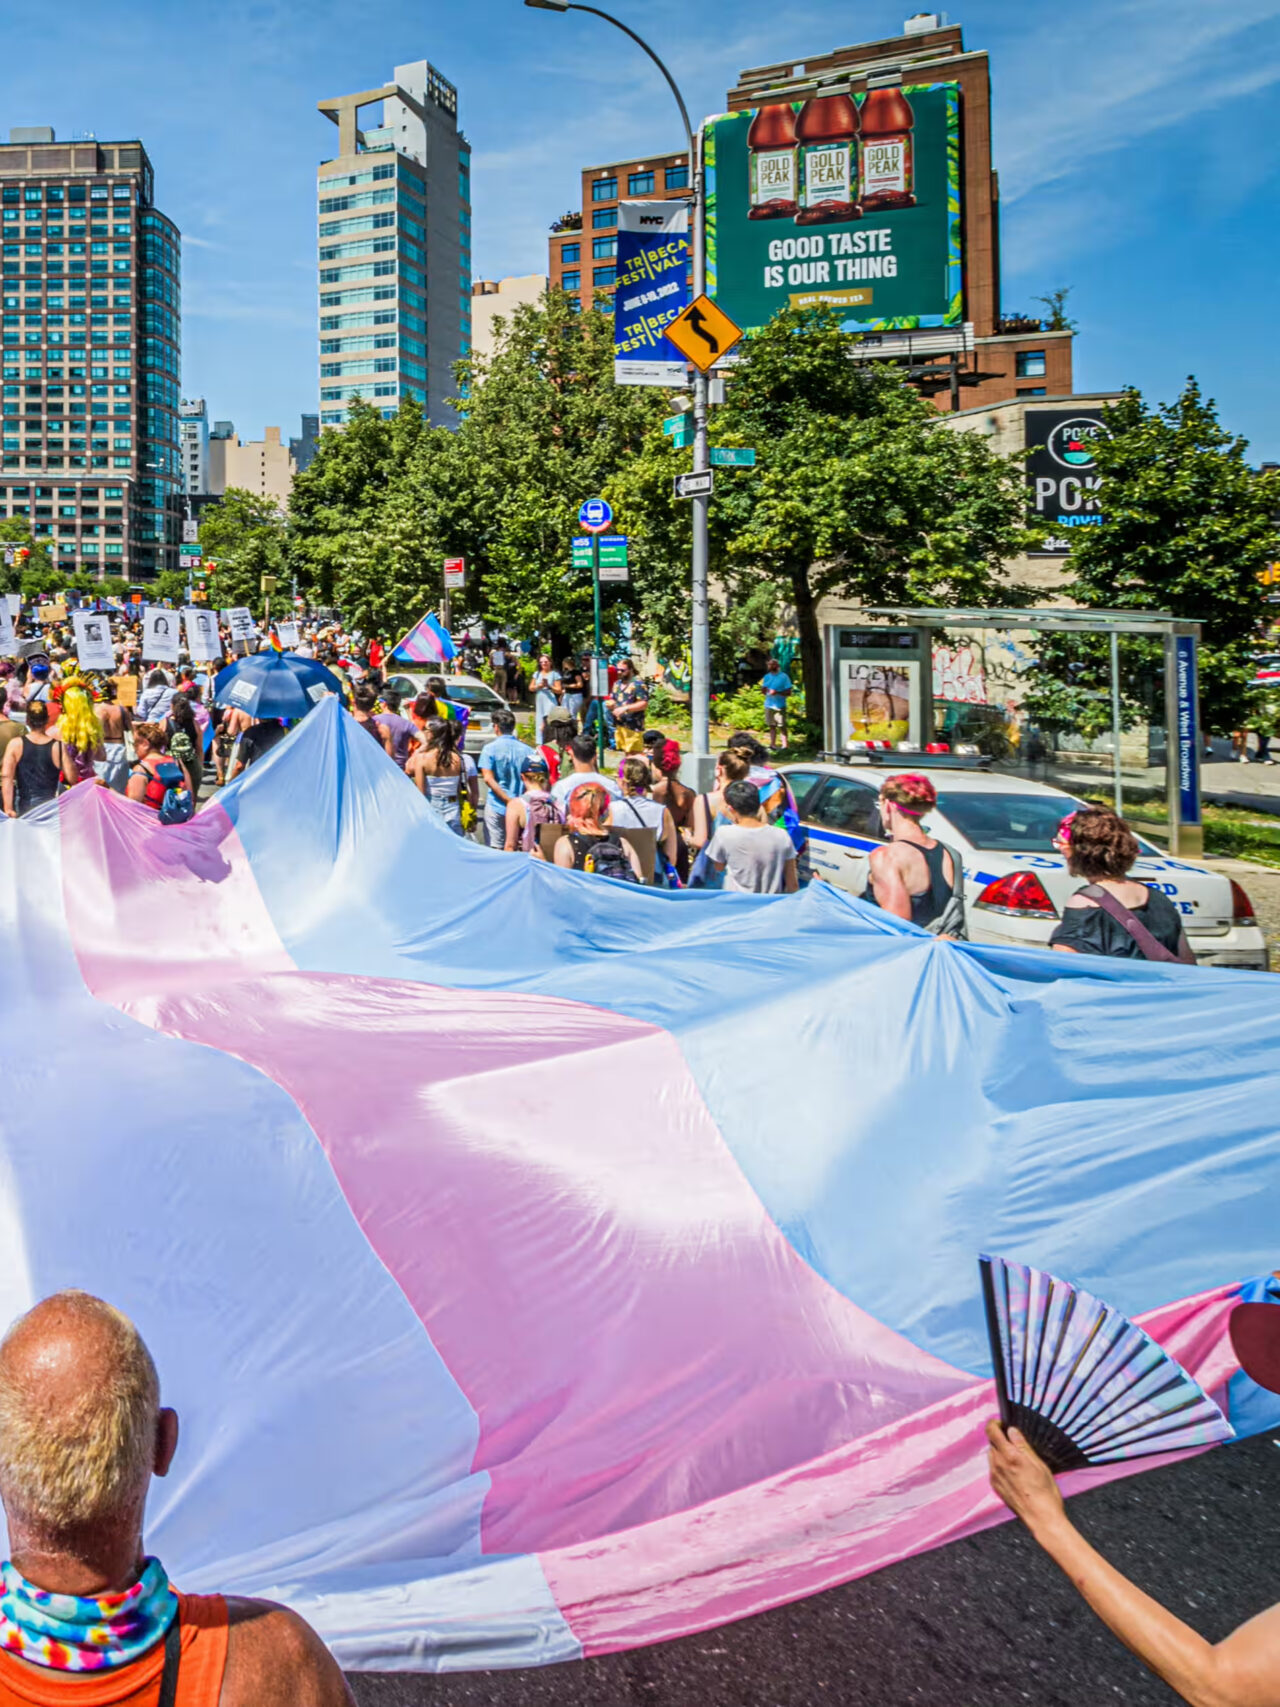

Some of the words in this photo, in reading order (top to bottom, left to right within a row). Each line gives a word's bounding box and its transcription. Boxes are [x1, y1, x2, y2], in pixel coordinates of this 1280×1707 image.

[810, 151, 845, 169] GOLD
[868, 146, 900, 161] GOLD
[761, 157, 790, 172] GOLD
[868, 159, 900, 174] PEAK
[761, 170, 790, 184] PEAK
[810, 167, 845, 184] PEAK
[640, 215, 664, 225] NYC
[768, 235, 824, 262] GOOD
[827, 228, 892, 255] TASTE
[763, 265, 784, 288] IS
[787, 261, 830, 285] OUR
[834, 255, 897, 281] THING
[849, 294, 864, 303] TEA
[1178, 660, 1189, 698] Avenue
[1180, 711, 1191, 737] West
[1180, 740, 1193, 792] Broadway
